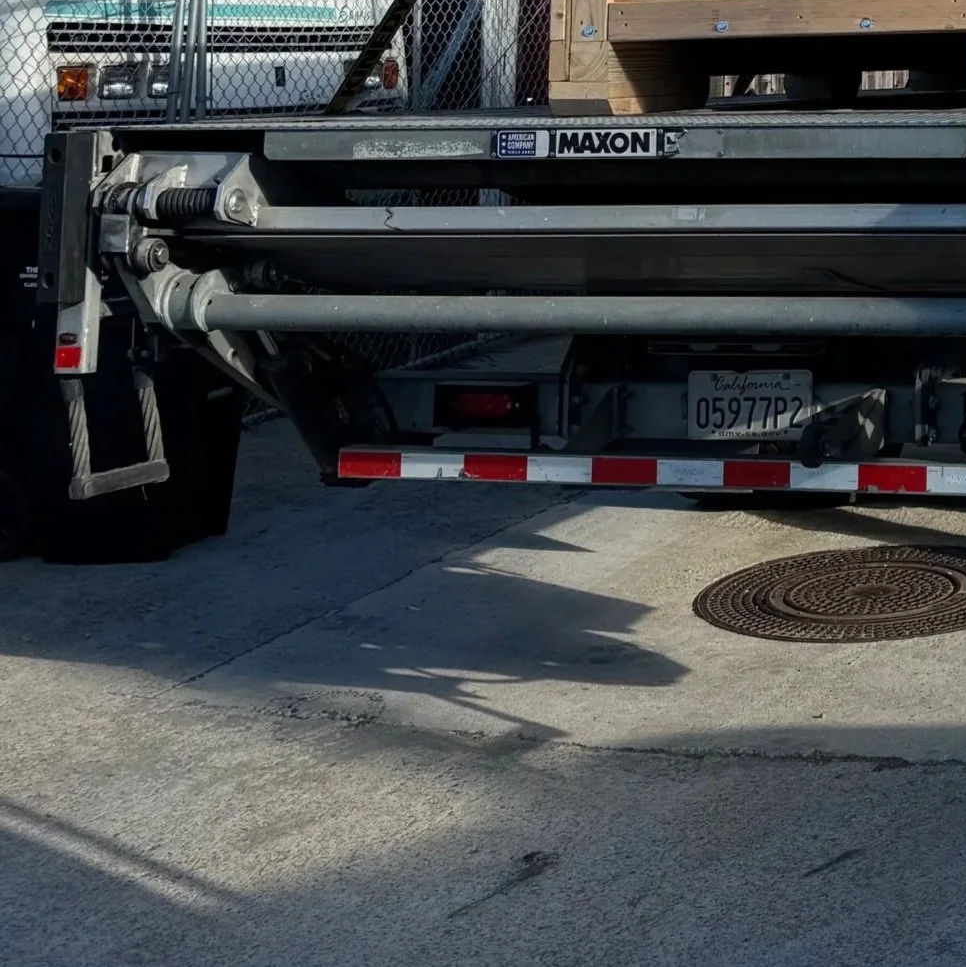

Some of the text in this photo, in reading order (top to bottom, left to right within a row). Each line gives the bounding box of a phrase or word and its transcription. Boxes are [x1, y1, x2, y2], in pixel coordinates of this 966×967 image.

[507, 141, 534, 149] COMPANY
[558, 132, 650, 154] MAXON
[714, 376, 790, 395] California
[696, 397, 804, 430] 05977P2
